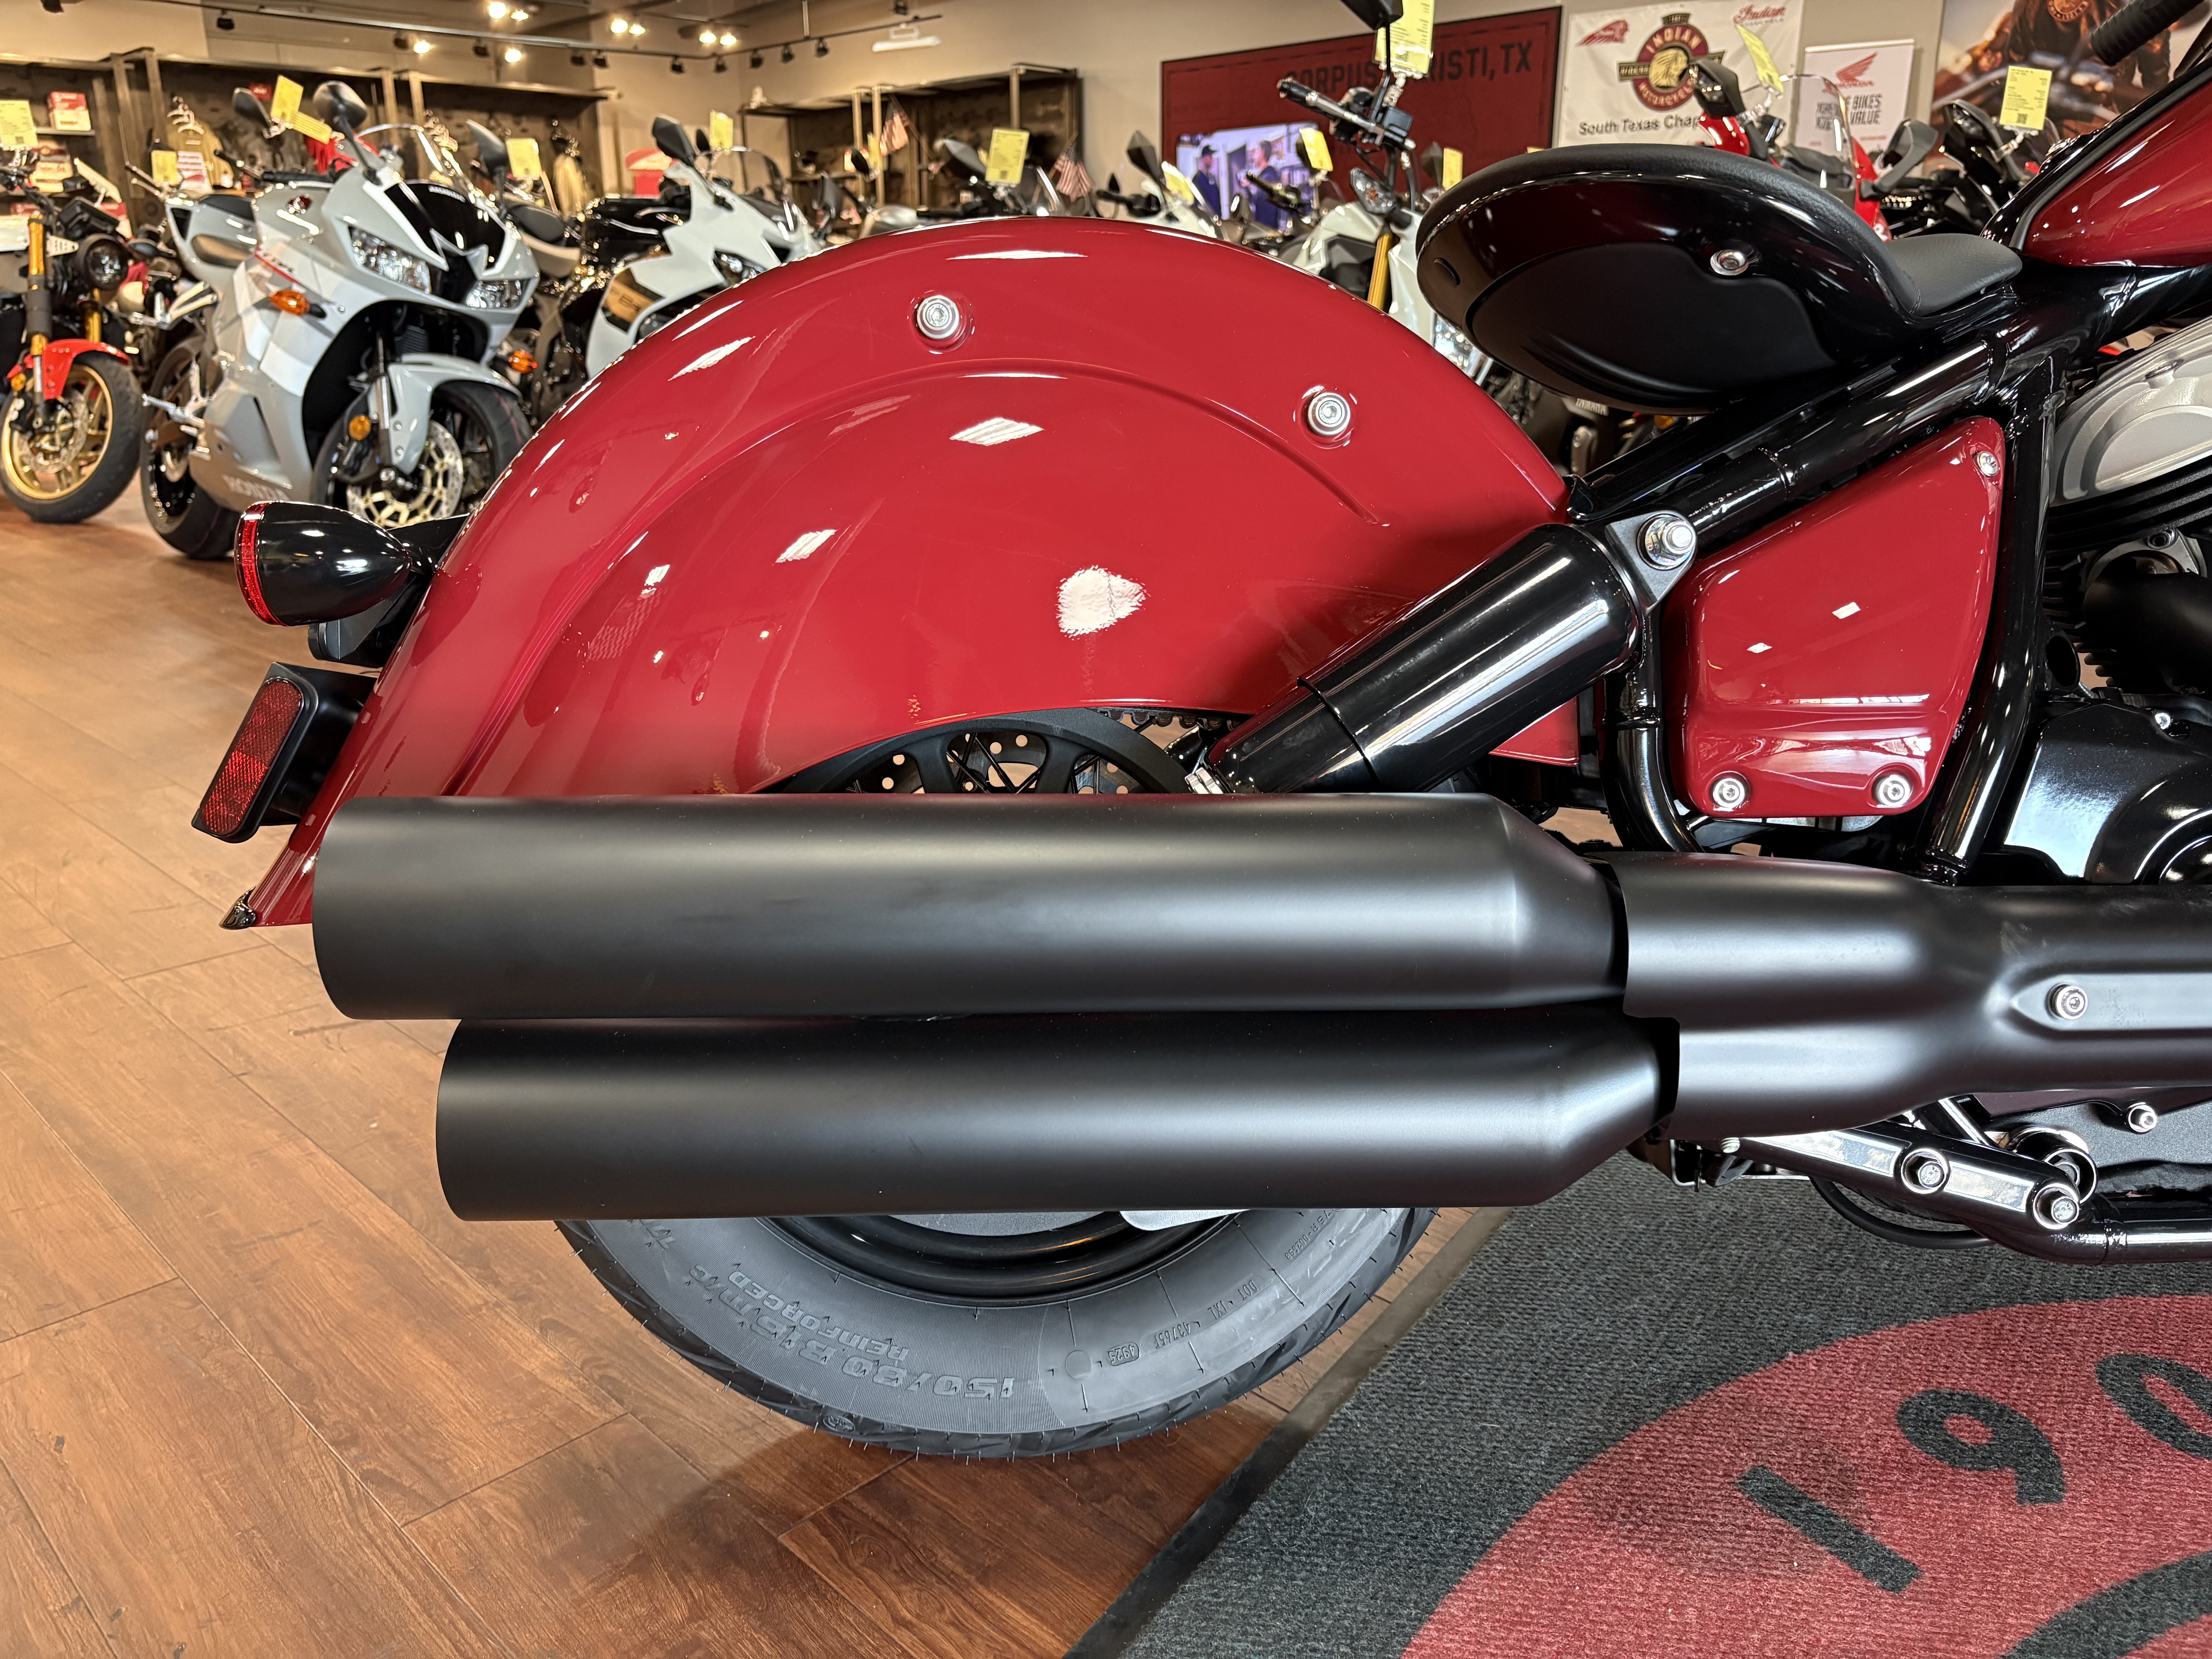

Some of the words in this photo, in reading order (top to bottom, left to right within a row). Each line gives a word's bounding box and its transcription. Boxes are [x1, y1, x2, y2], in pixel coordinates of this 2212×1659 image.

[1645, 26, 1702, 54] INDIAN
[1286, 62, 1379, 94] ORPUS
[1500, 40, 1532, 74] TX
[1852, 94, 1883, 109] BIKES
[1579, 119, 1617, 135] South
[1623, 118, 1659, 131] Texas
[1664, 115, 1699, 129] Chap
[1850, 110, 1882, 125] VALUE
[222, 474, 290, 501] HONDA
[1238, 1279, 1259, 1300] DOT
[728, 1271, 908, 1361] REINFORCED
[751, 1315, 837, 1365] B16
[1108, 1345, 1136, 1364] 4925
[842, 1355, 1015, 1399] 150/80
